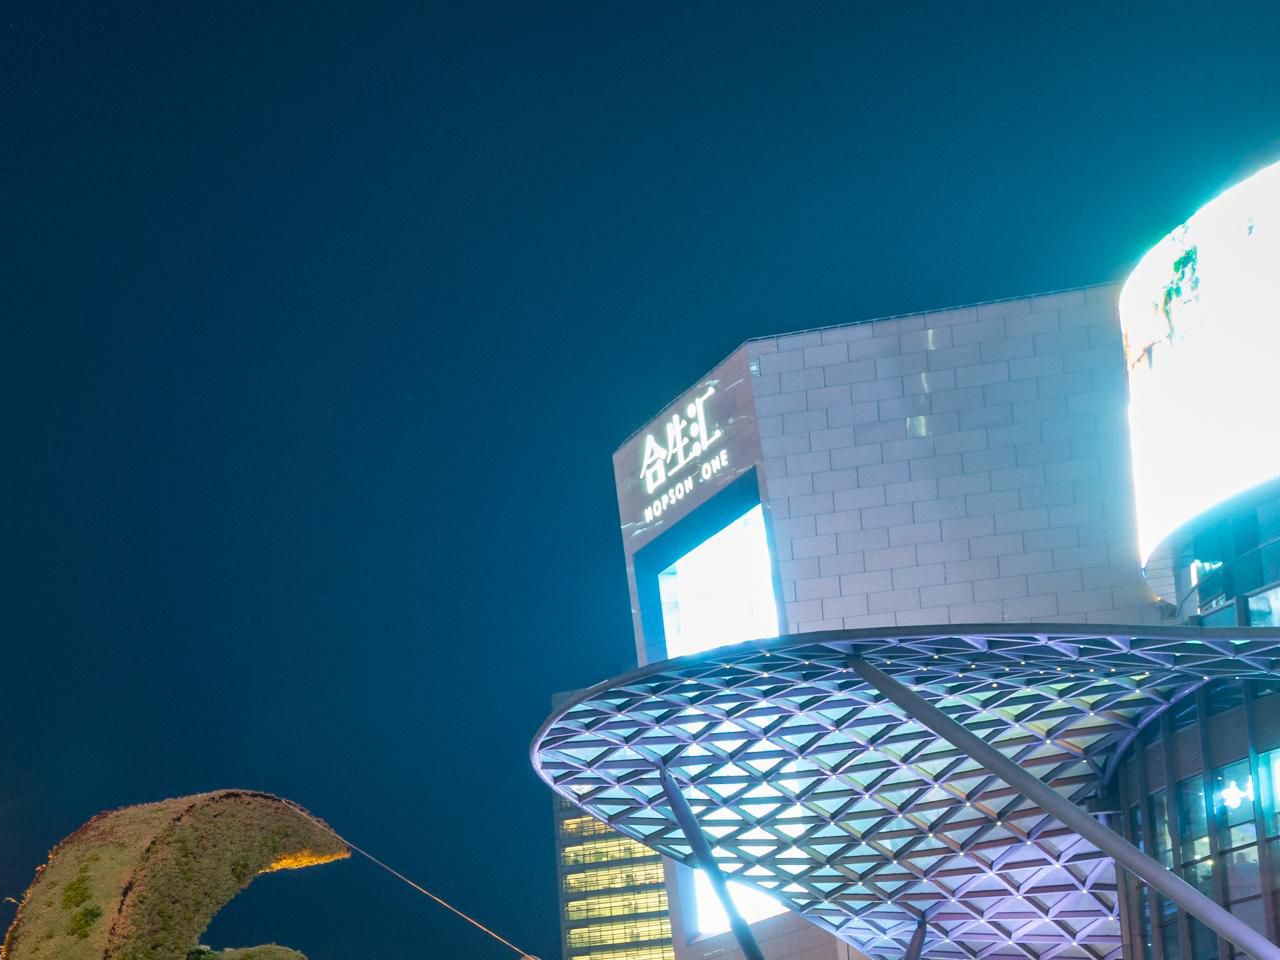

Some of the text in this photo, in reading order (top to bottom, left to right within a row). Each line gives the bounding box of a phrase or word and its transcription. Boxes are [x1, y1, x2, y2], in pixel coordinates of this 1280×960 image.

[640, 386, 723, 494] 合生汇
[643, 448, 730, 523] HOPSON ONE
